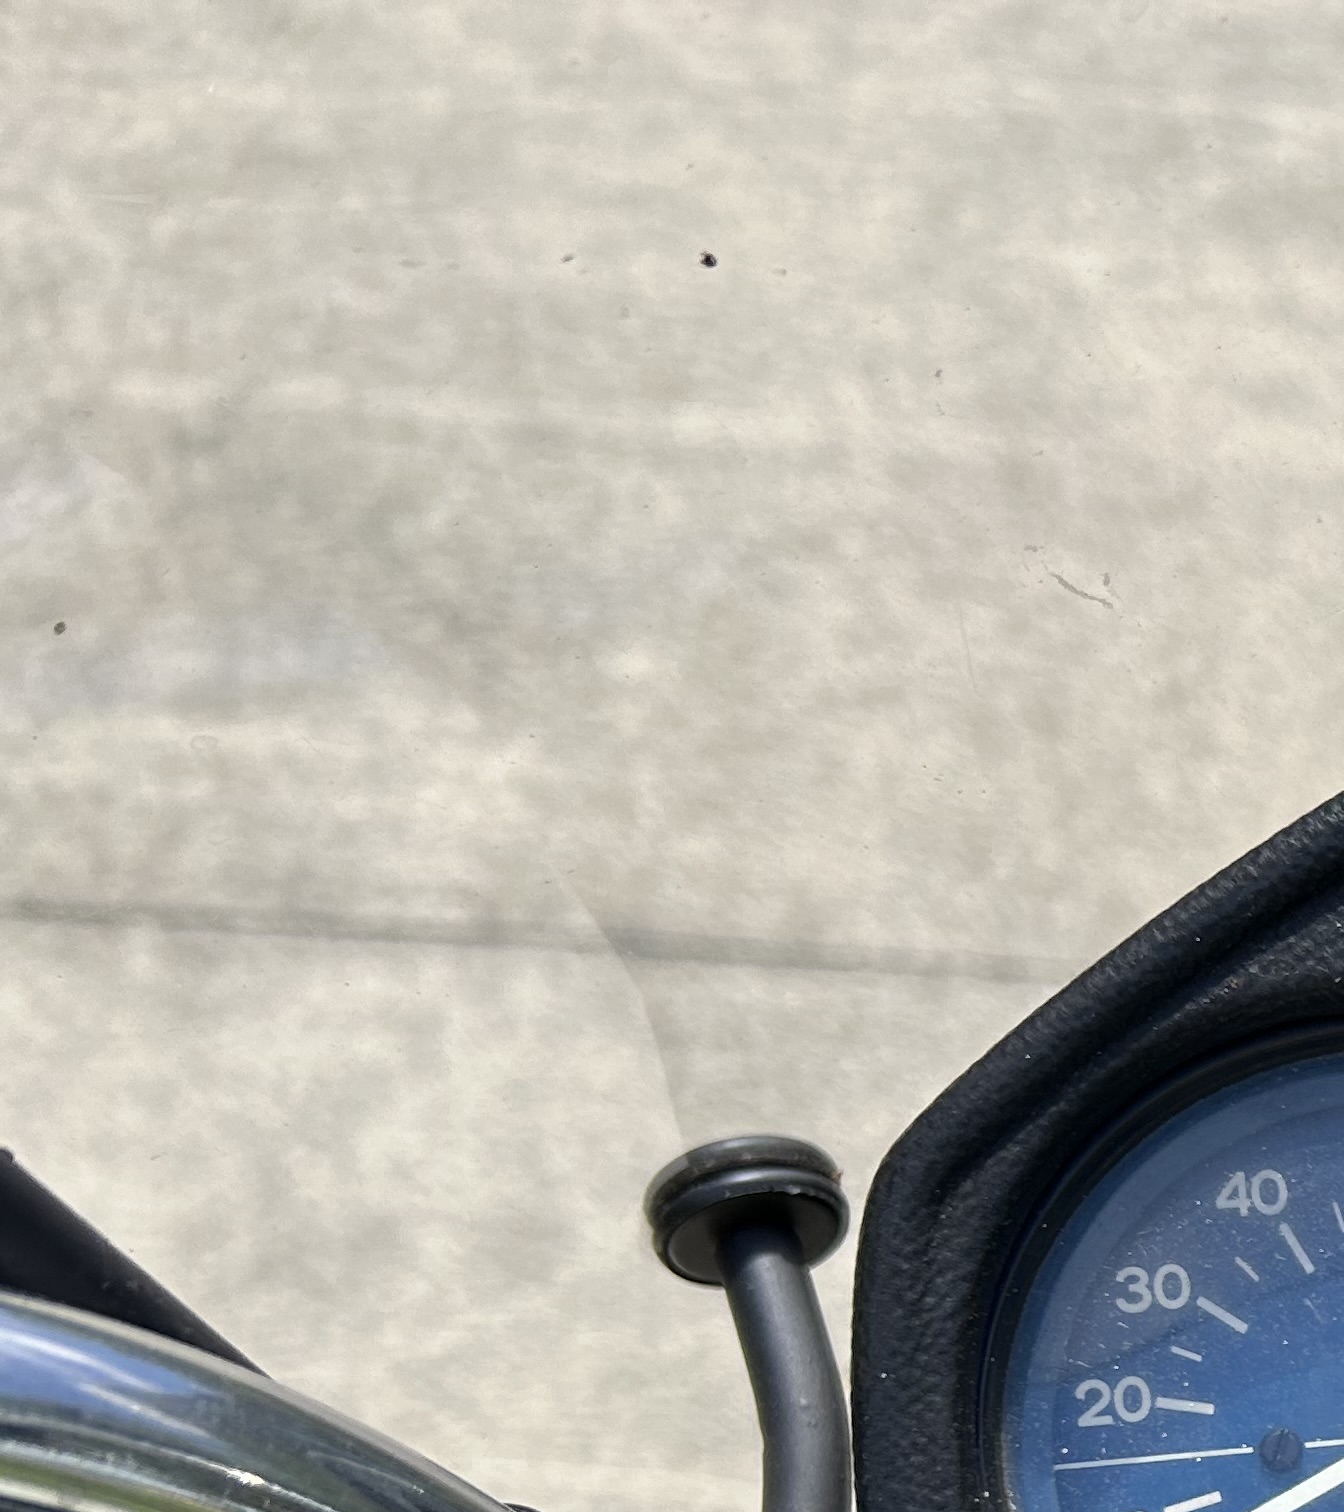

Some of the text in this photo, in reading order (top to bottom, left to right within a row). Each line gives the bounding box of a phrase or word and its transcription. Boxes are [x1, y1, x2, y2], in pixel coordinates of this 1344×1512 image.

[1216, 1168, 1288, 1218] 40
[1115, 1263, 1191, 1313] 30
[1075, 1375, 1152, 1427] 20
